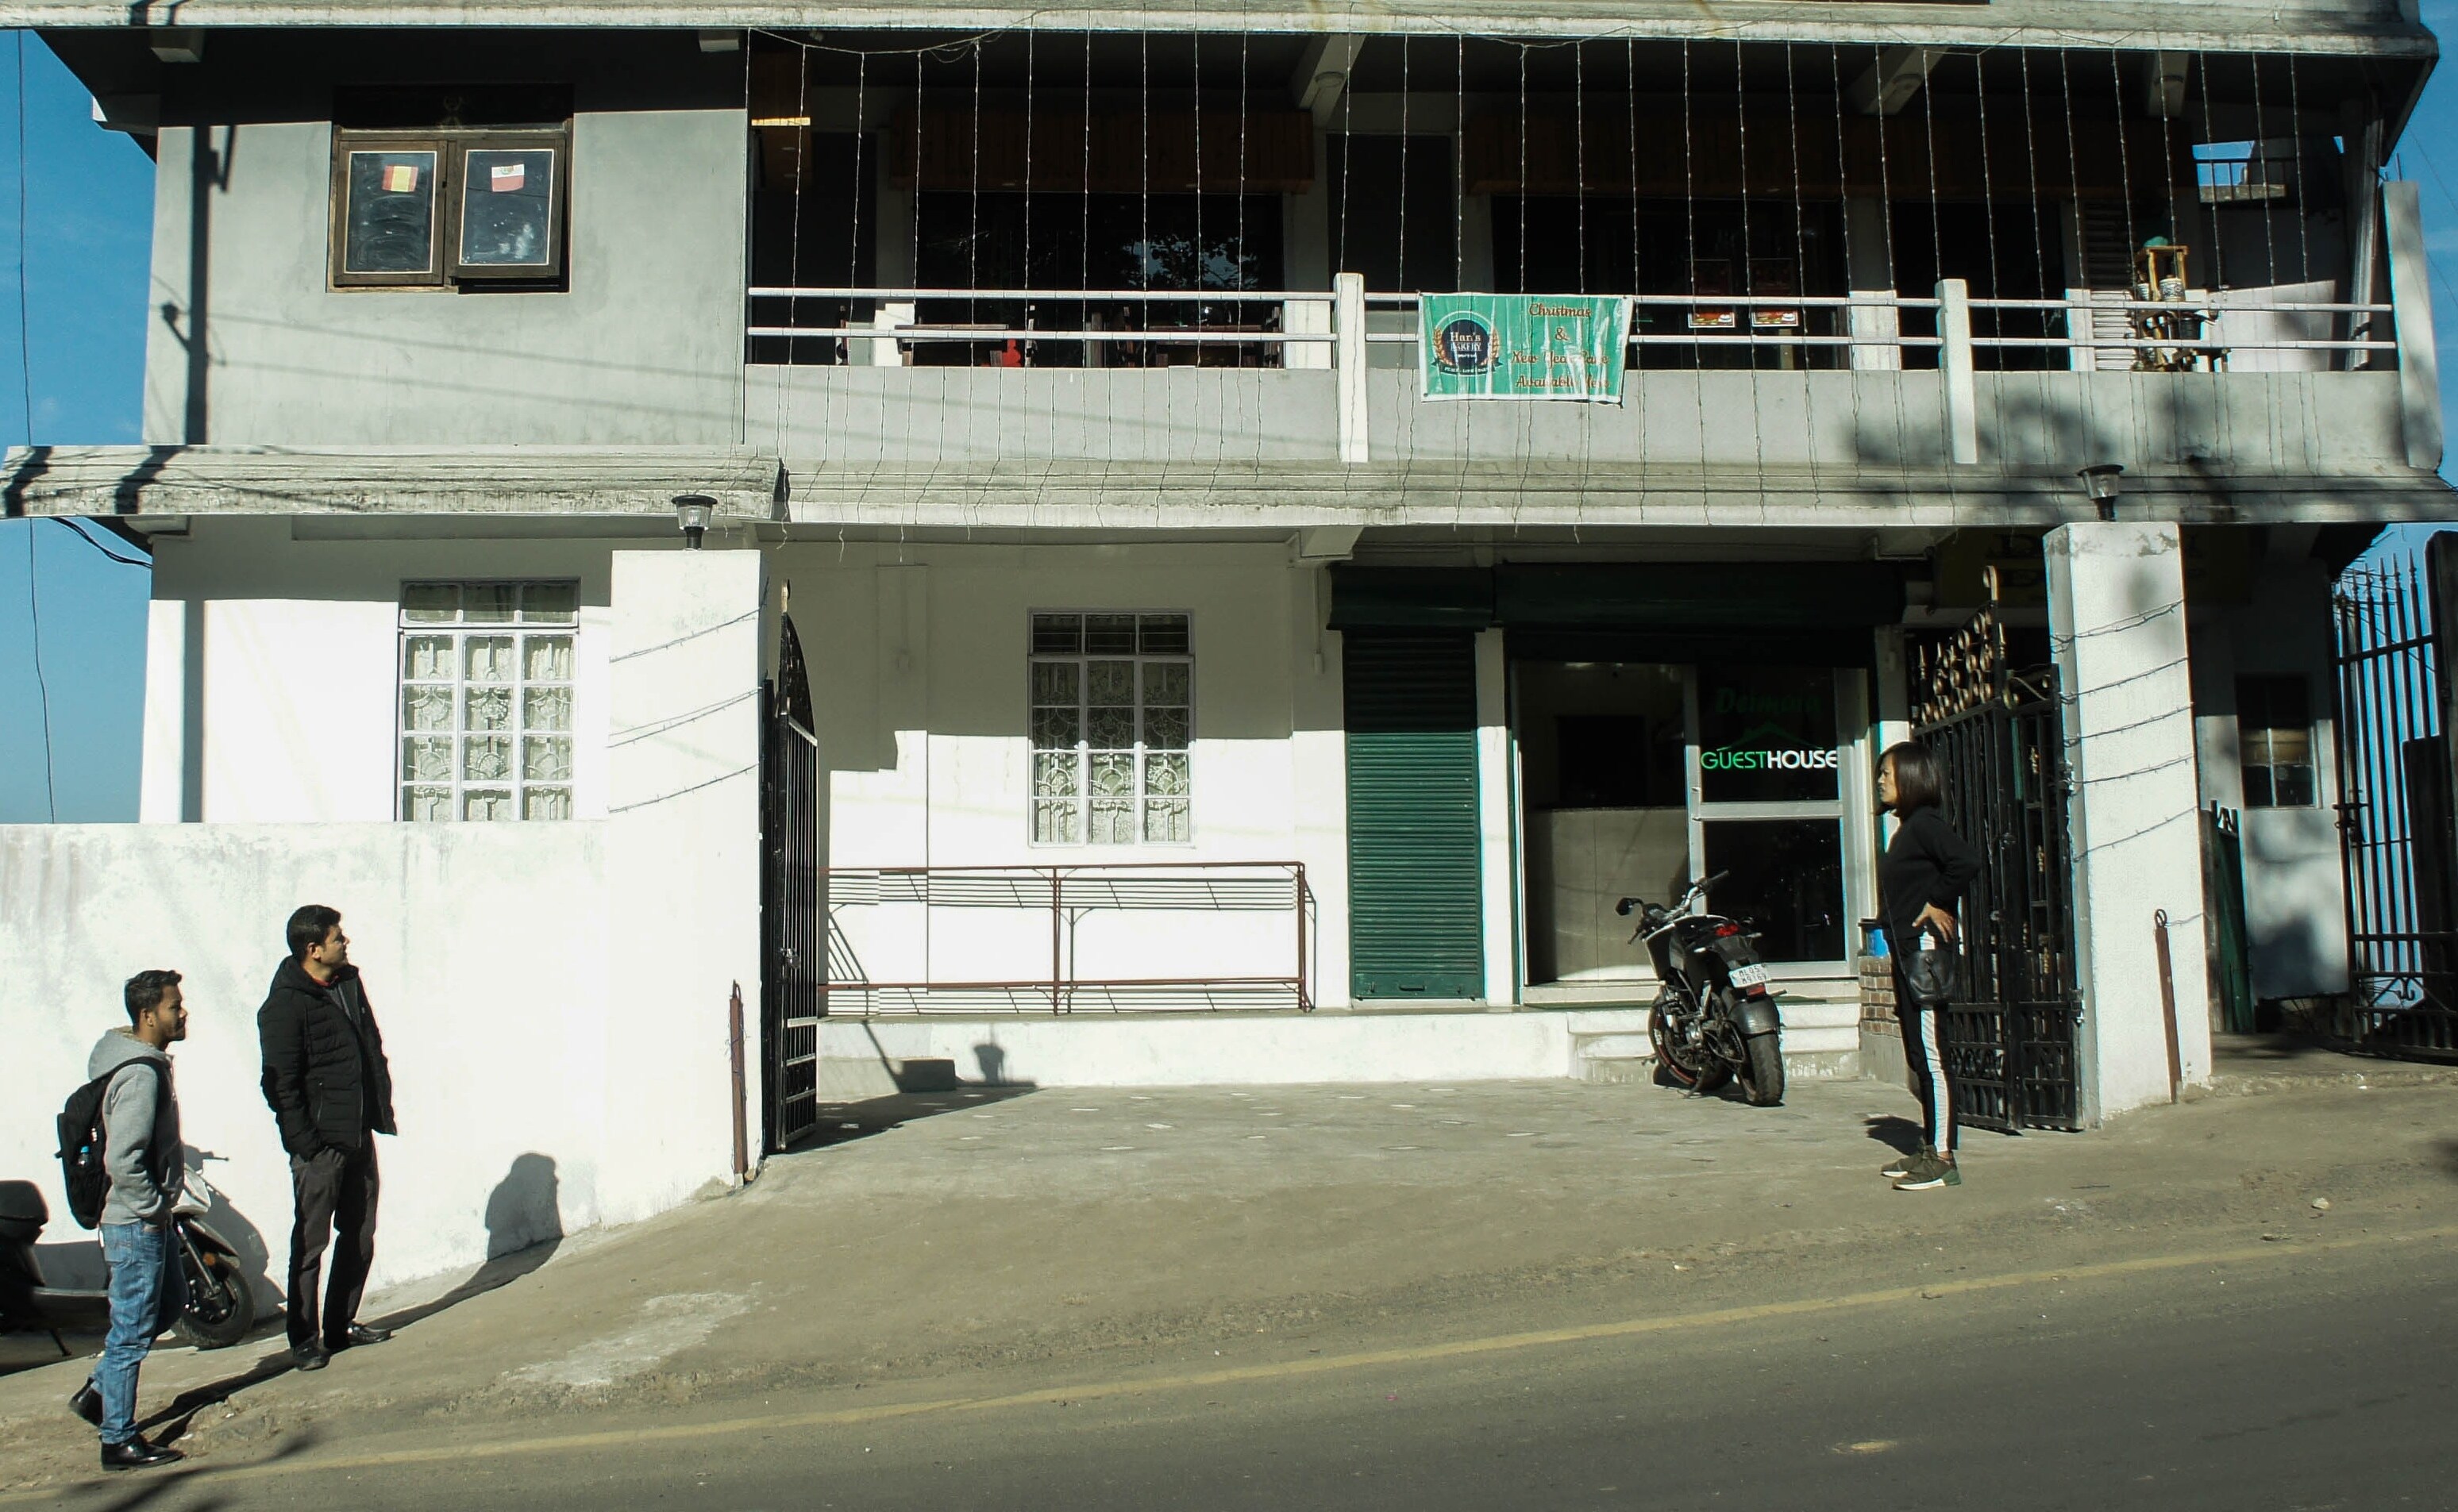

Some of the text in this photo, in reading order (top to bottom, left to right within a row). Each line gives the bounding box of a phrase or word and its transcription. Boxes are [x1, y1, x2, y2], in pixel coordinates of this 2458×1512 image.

[1529, 302, 1592, 317] Christmas
[1451, 332, 1481, 342] Han's
[1555, 327, 1570, 341] &
[1512, 350, 1538, 364] New
[1543, 350, 1572, 368] Yea
[1516, 375, 1576, 388] Avaiabl
[1700, 749, 1837, 770] GUESTHOUSE
